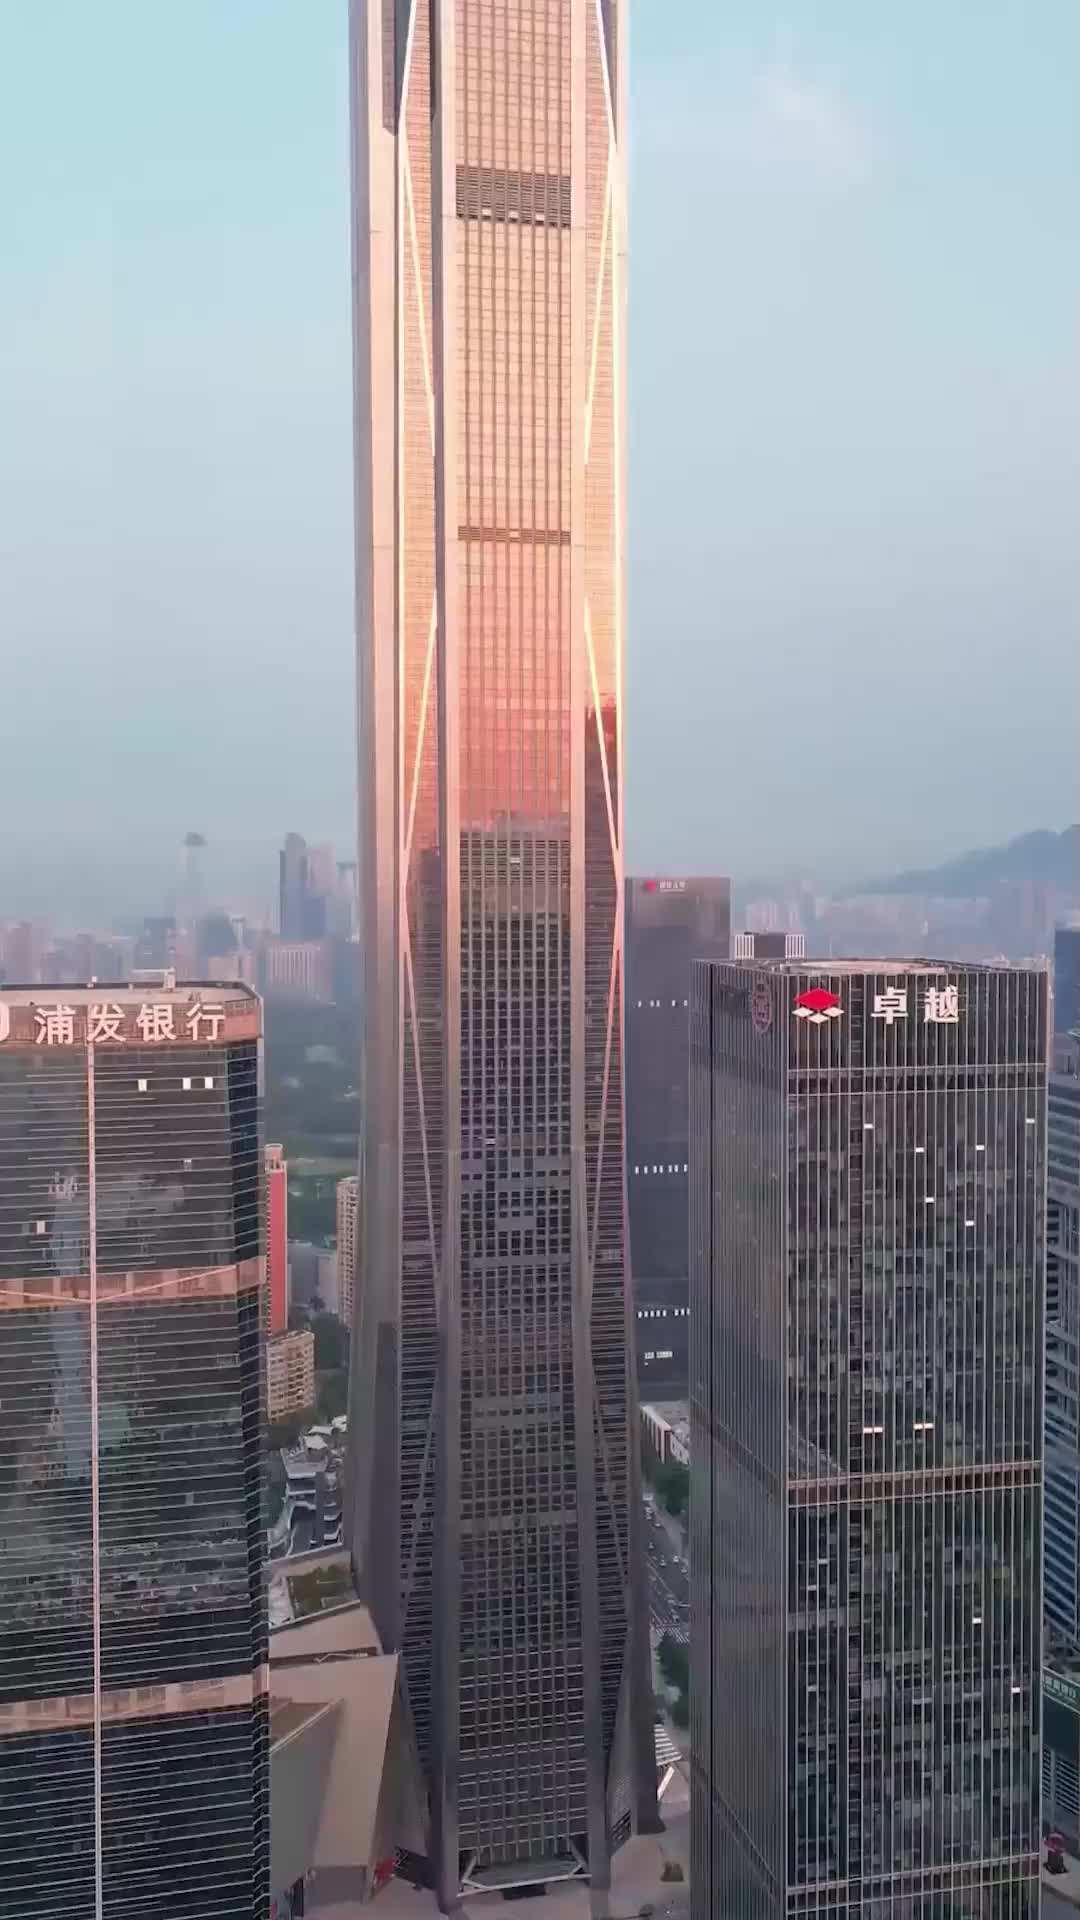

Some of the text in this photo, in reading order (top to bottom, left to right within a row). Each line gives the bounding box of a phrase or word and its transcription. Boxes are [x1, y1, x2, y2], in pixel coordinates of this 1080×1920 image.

[33, 1002, 226, 1045] 浦发银行
[870, 984, 960, 1025] 卓越
